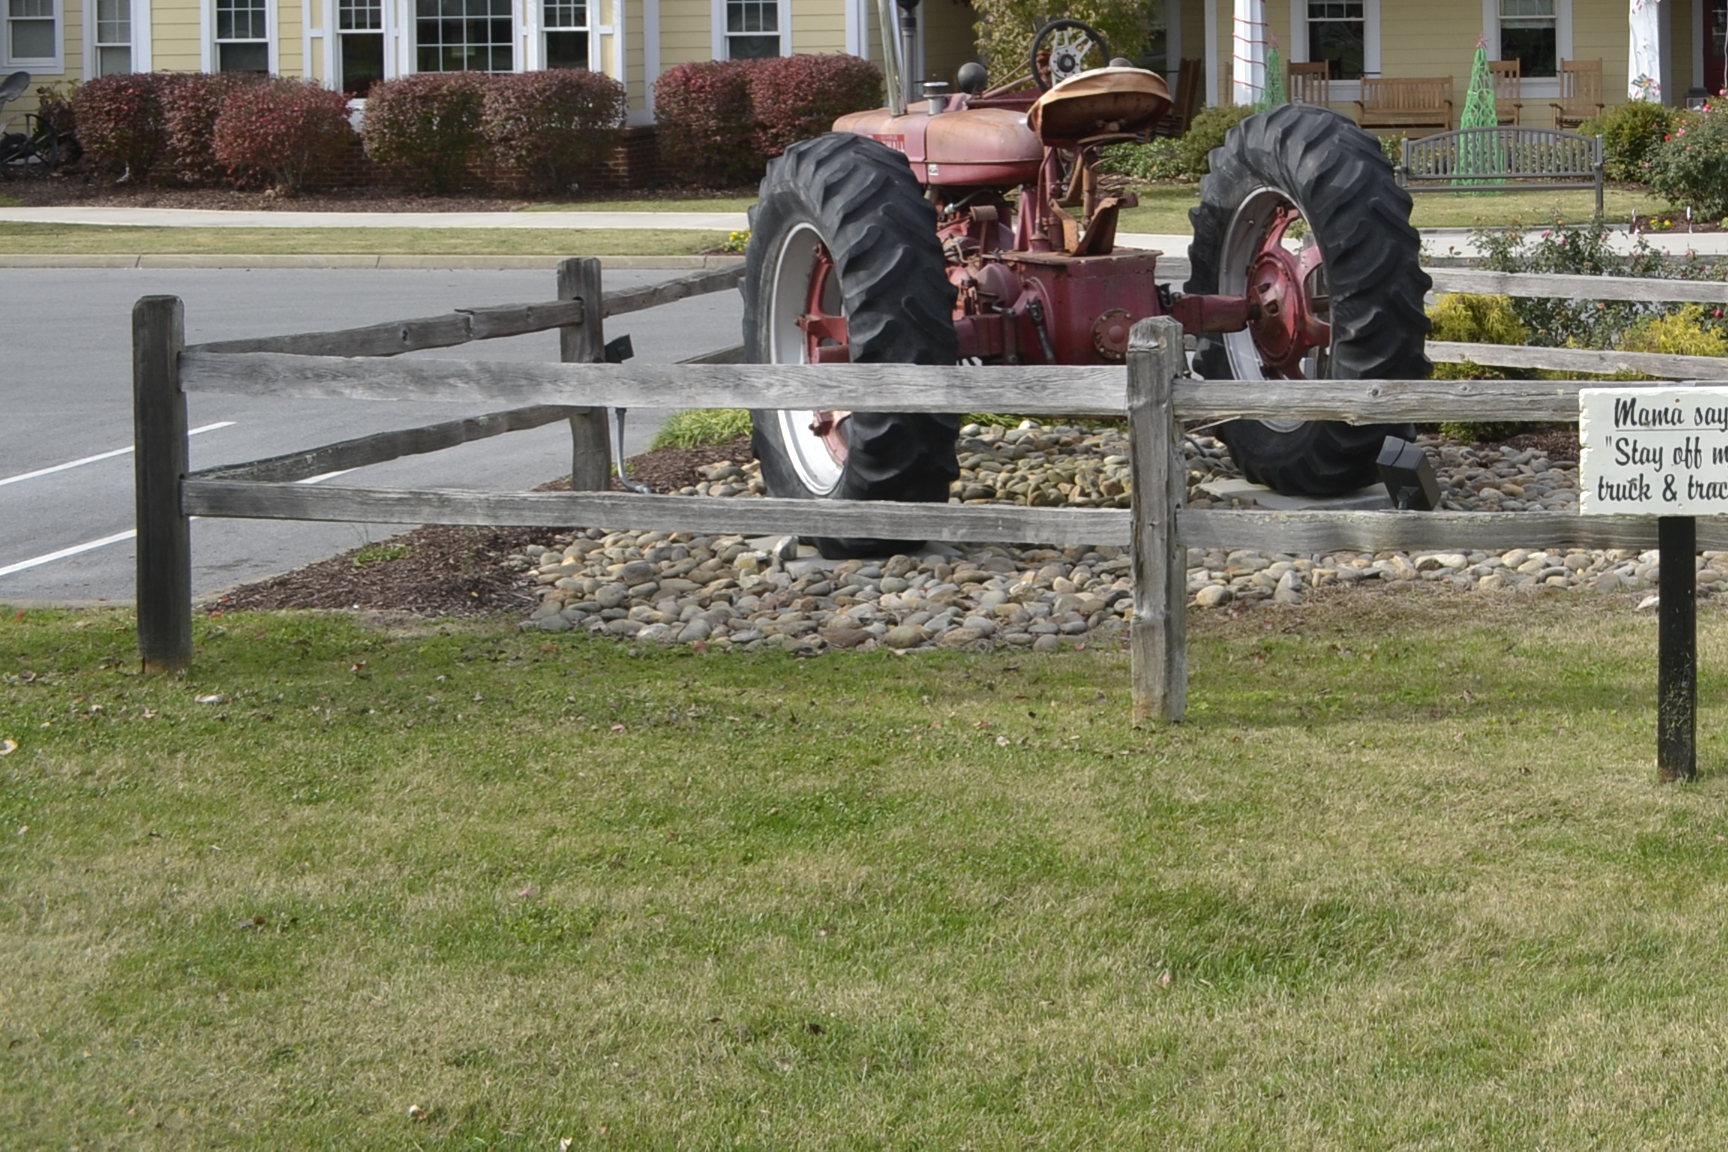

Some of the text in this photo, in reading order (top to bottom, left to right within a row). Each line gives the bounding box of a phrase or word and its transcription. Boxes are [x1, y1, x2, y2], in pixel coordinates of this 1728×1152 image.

[1614, 397, 1685, 428] Mama
[1605, 436, 1664, 473] "Stay
[1673, 436, 1703, 469] off
[1598, 473, 1653, 503] truck
[1662, 473, 1678, 502] &
